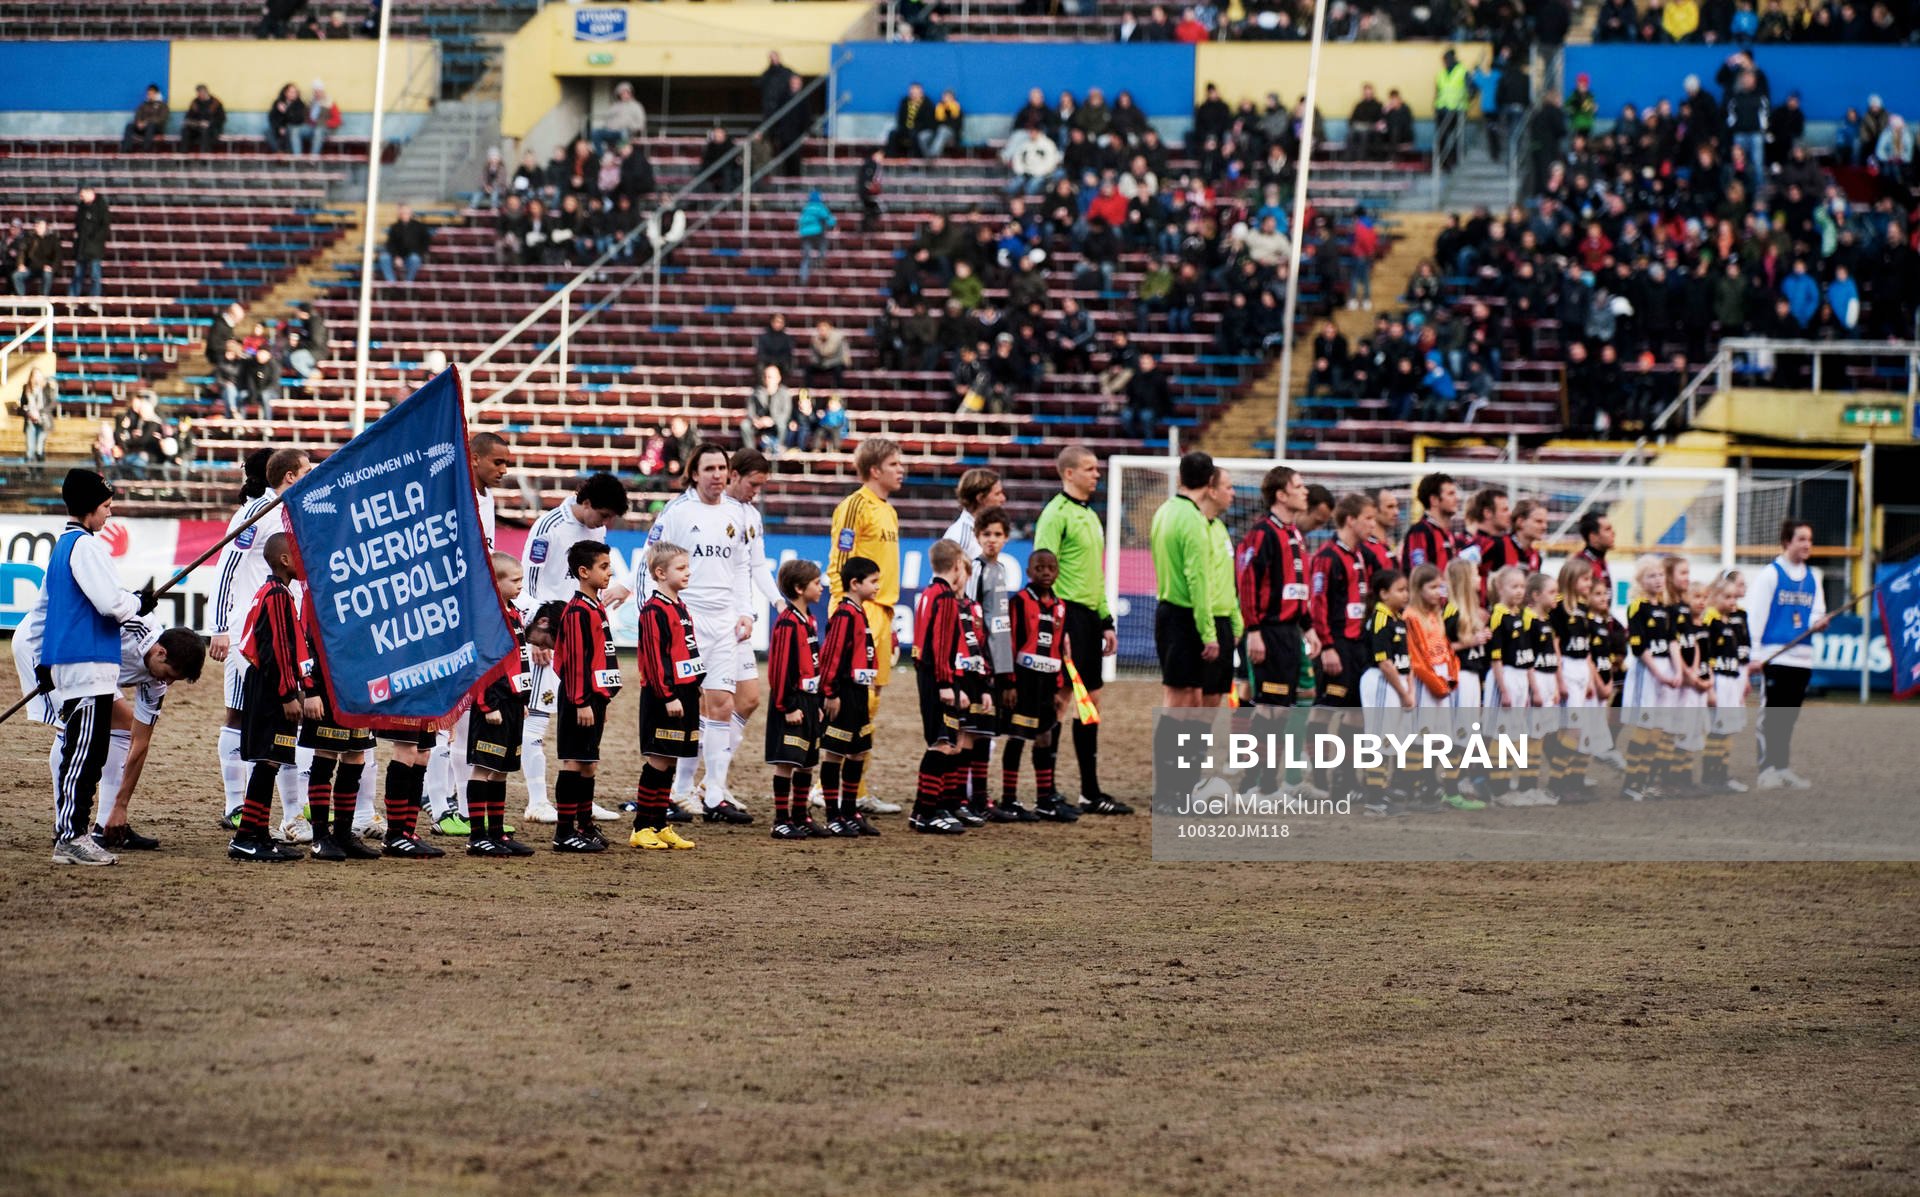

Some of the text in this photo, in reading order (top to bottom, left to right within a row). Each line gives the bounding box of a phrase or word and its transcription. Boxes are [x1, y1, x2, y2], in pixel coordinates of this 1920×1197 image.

[337, 458, 402, 490] VÄLKOMMEN
[402, 452, 415, 468] IN
[350, 480, 426, 534] HELA
[329, 508, 459, 584] SVERIGES
[333, 547, 468, 624] FOTBOLLS
[370, 595, 461, 655] KLUBB
[390, 650, 474, 692] STRYKTIPSET
